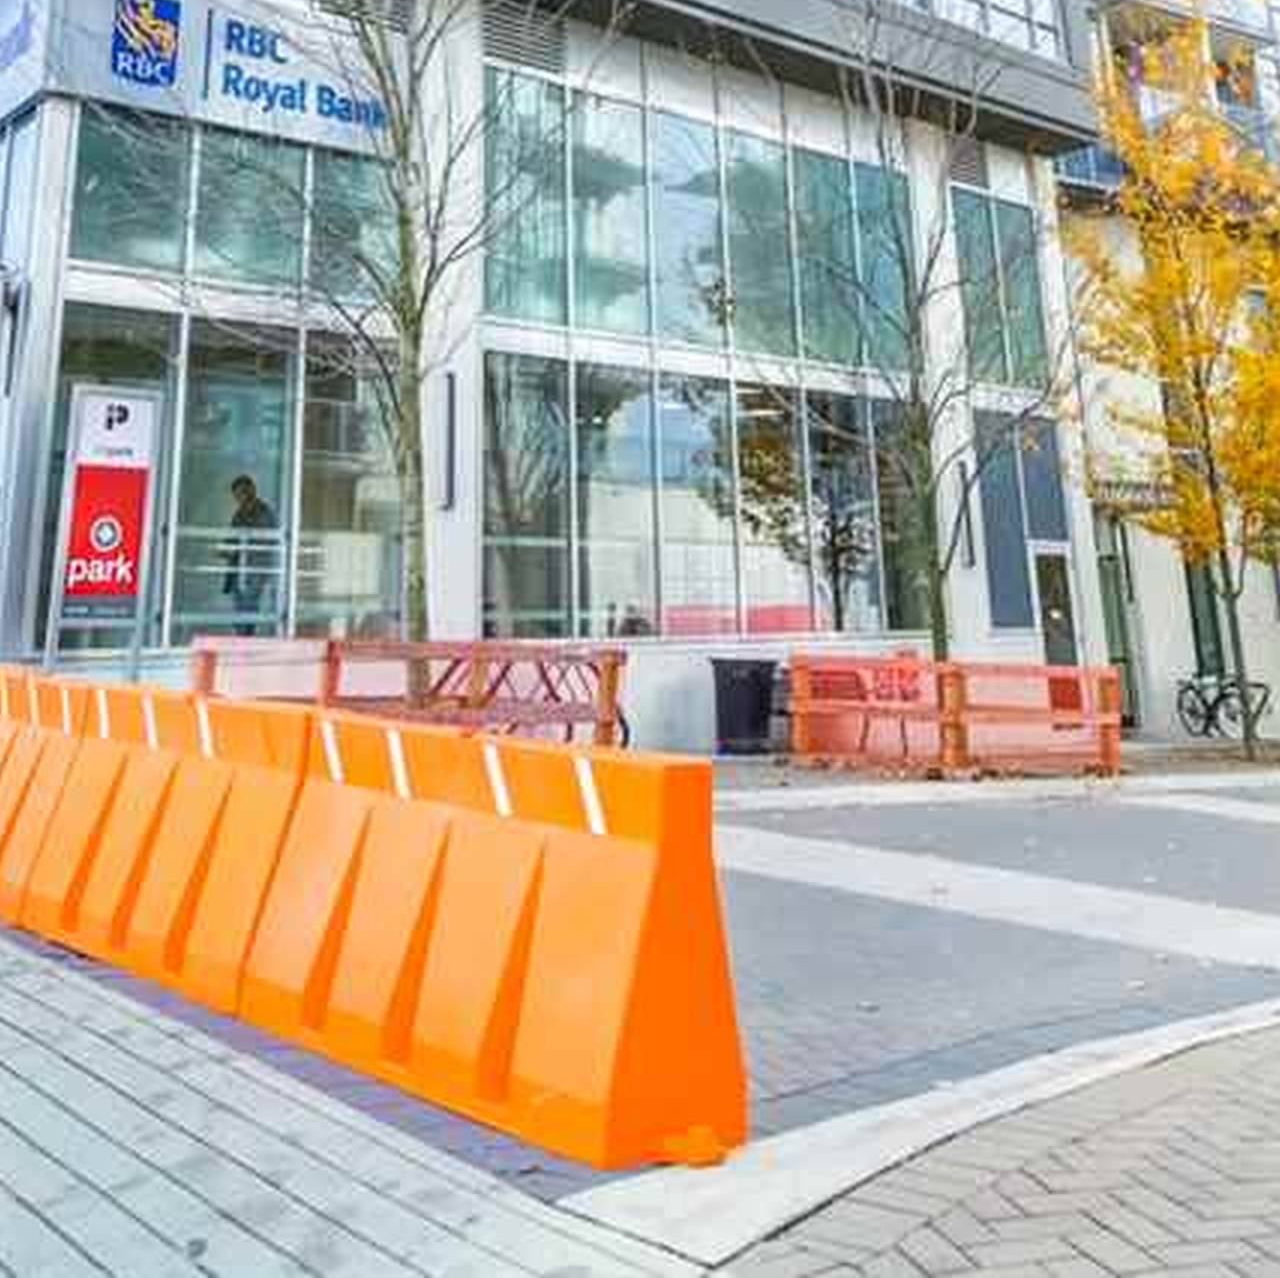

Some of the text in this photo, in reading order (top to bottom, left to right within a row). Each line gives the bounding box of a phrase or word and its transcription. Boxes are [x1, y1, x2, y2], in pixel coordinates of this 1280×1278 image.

[224, 17, 288, 65] RBC
[116, 50, 173, 84] RBC
[222, 64, 389, 128] Royal Bank
[66, 553, 134, 589] park
